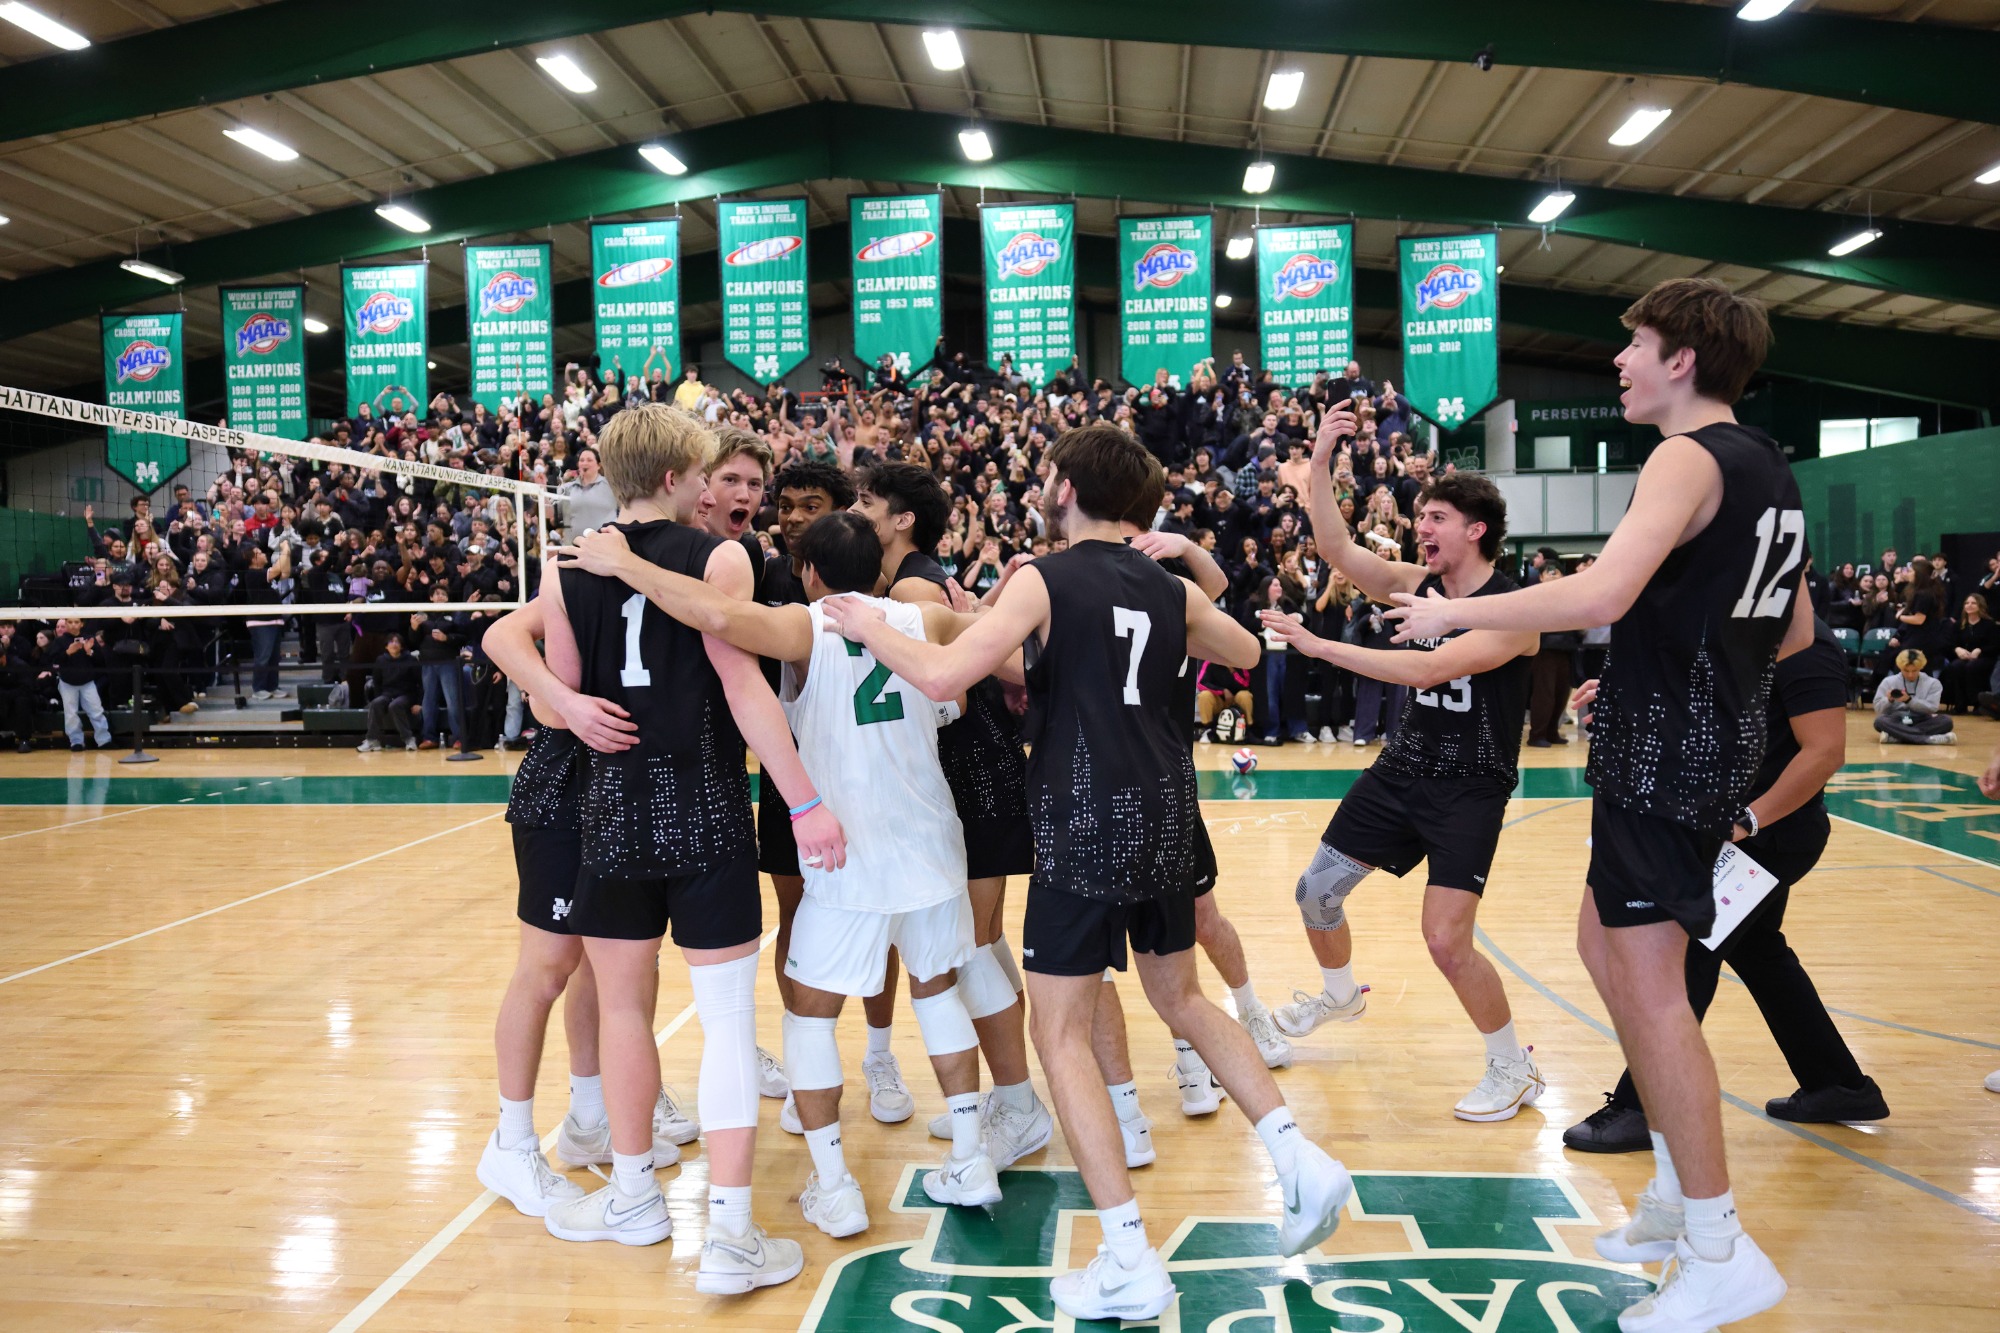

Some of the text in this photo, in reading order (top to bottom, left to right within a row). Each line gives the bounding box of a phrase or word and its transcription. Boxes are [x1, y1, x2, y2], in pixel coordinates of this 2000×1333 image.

[1003, 242, 1054, 274] MAAC
[1137, 253, 1192, 284] MAAC
[726, 280, 804, 296] CHAMPIONS
[857, 276, 936, 292] CHAMPIONS
[1278, 263, 1333, 295] MAAC
[1420, 273, 1475, 306] MAAC
[484, 280, 533, 312] MAAC
[598, 301, 675, 317] CHAMPIONS
[990, 286, 1071, 303] CHAMPIONS
[1125, 298, 1207, 314] CHAMPIONS
[359, 302, 407, 331] MAAC
[473, 321, 548, 336] CHAMPIONS
[1265, 307, 1348, 325] CHAMPIONS
[1407, 317, 1492, 336] CHAMPIONS
[238, 322, 286, 352] MAAC
[351, 342, 422, 358] CHAMPIONS
[118, 350, 167, 380] MAAC
[229, 363, 301, 378] CHAMPIONS
[109, 390, 180, 404] CHAMPIONS
[0, 389, 72, 417] HATTAN
[80, 403, 177, 434] UNIVERSITY
[181, 421, 245, 445] JASPERS
[383, 459, 517, 490] MANHATTAN UNIVERSITY JASPERS
[1731, 507, 1805, 618] 12
[620, 593, 651, 687] 1
[1113, 606, 1152, 706] 7
[843, 636, 905, 726] 2
[1713, 848, 1736, 878] ports
